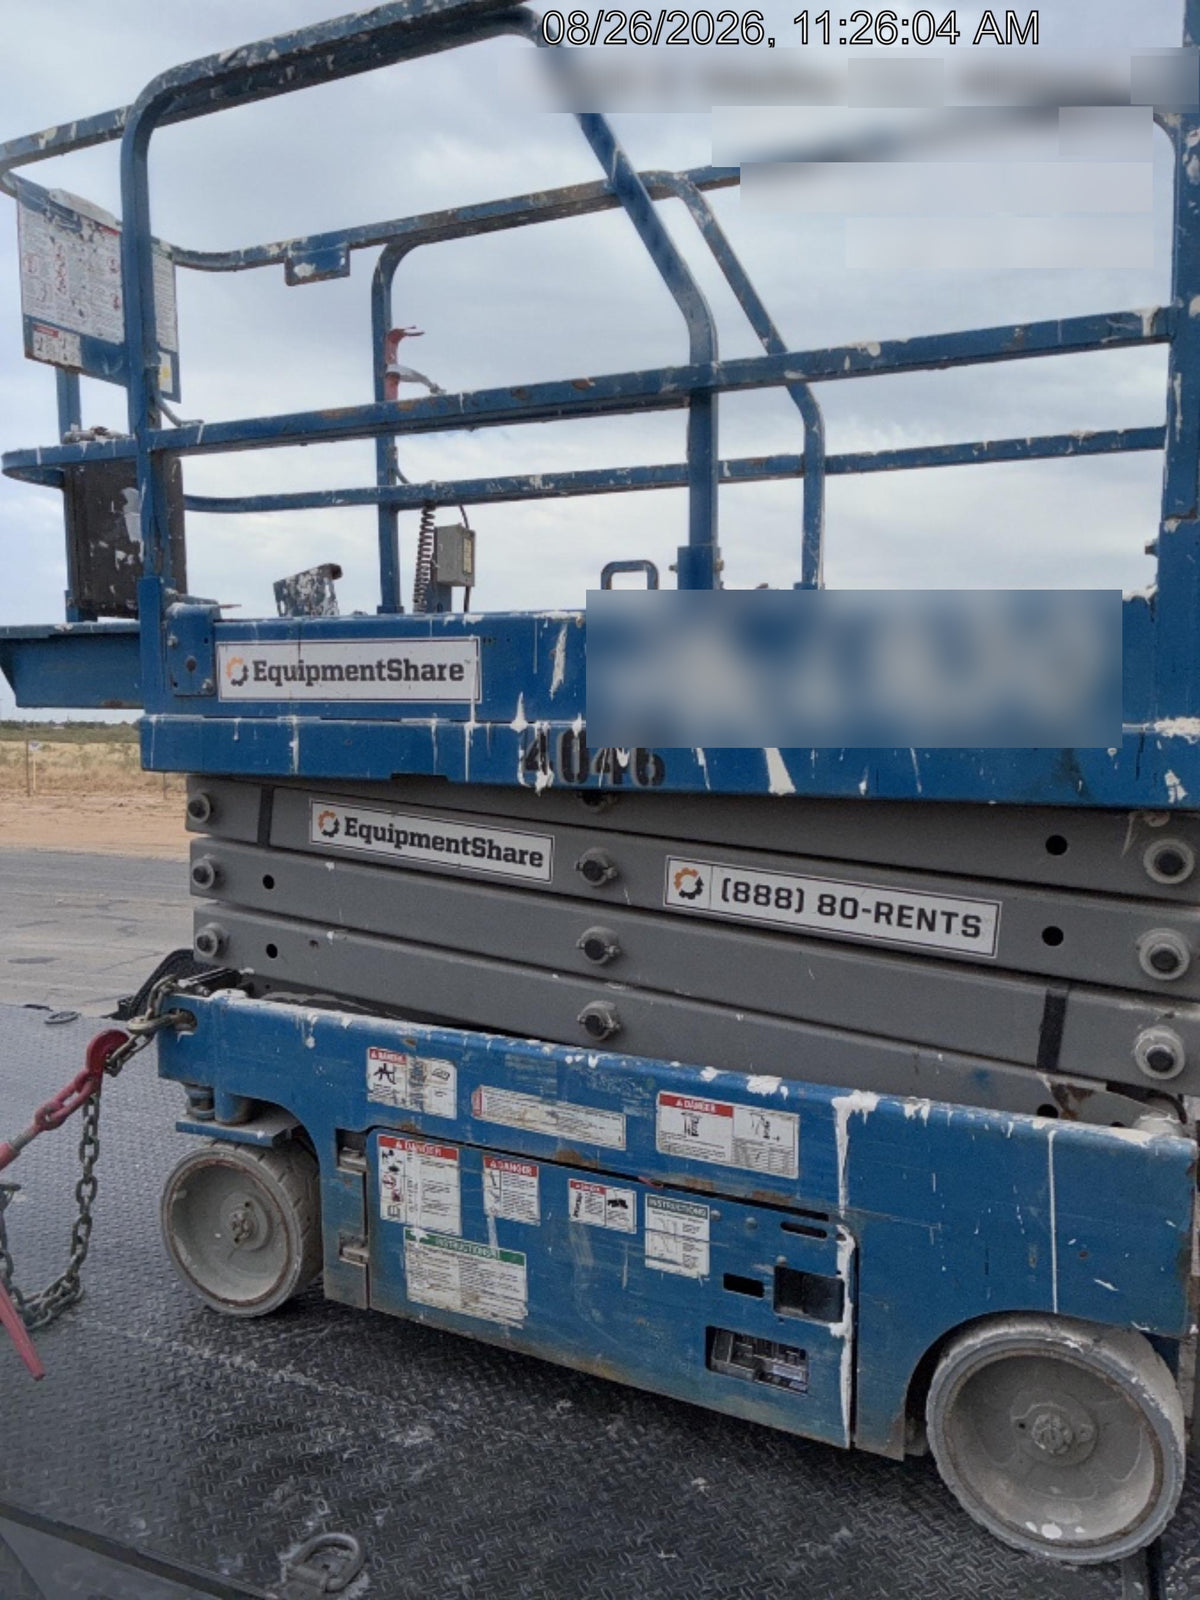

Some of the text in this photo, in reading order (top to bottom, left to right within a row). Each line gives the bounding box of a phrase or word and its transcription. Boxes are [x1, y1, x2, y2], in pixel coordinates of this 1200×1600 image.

[252, 658, 465, 687] EquipmentShare
[344, 816, 544, 868] EquipmentShare
[721, 877, 982, 939] (888) 80-RENTS
